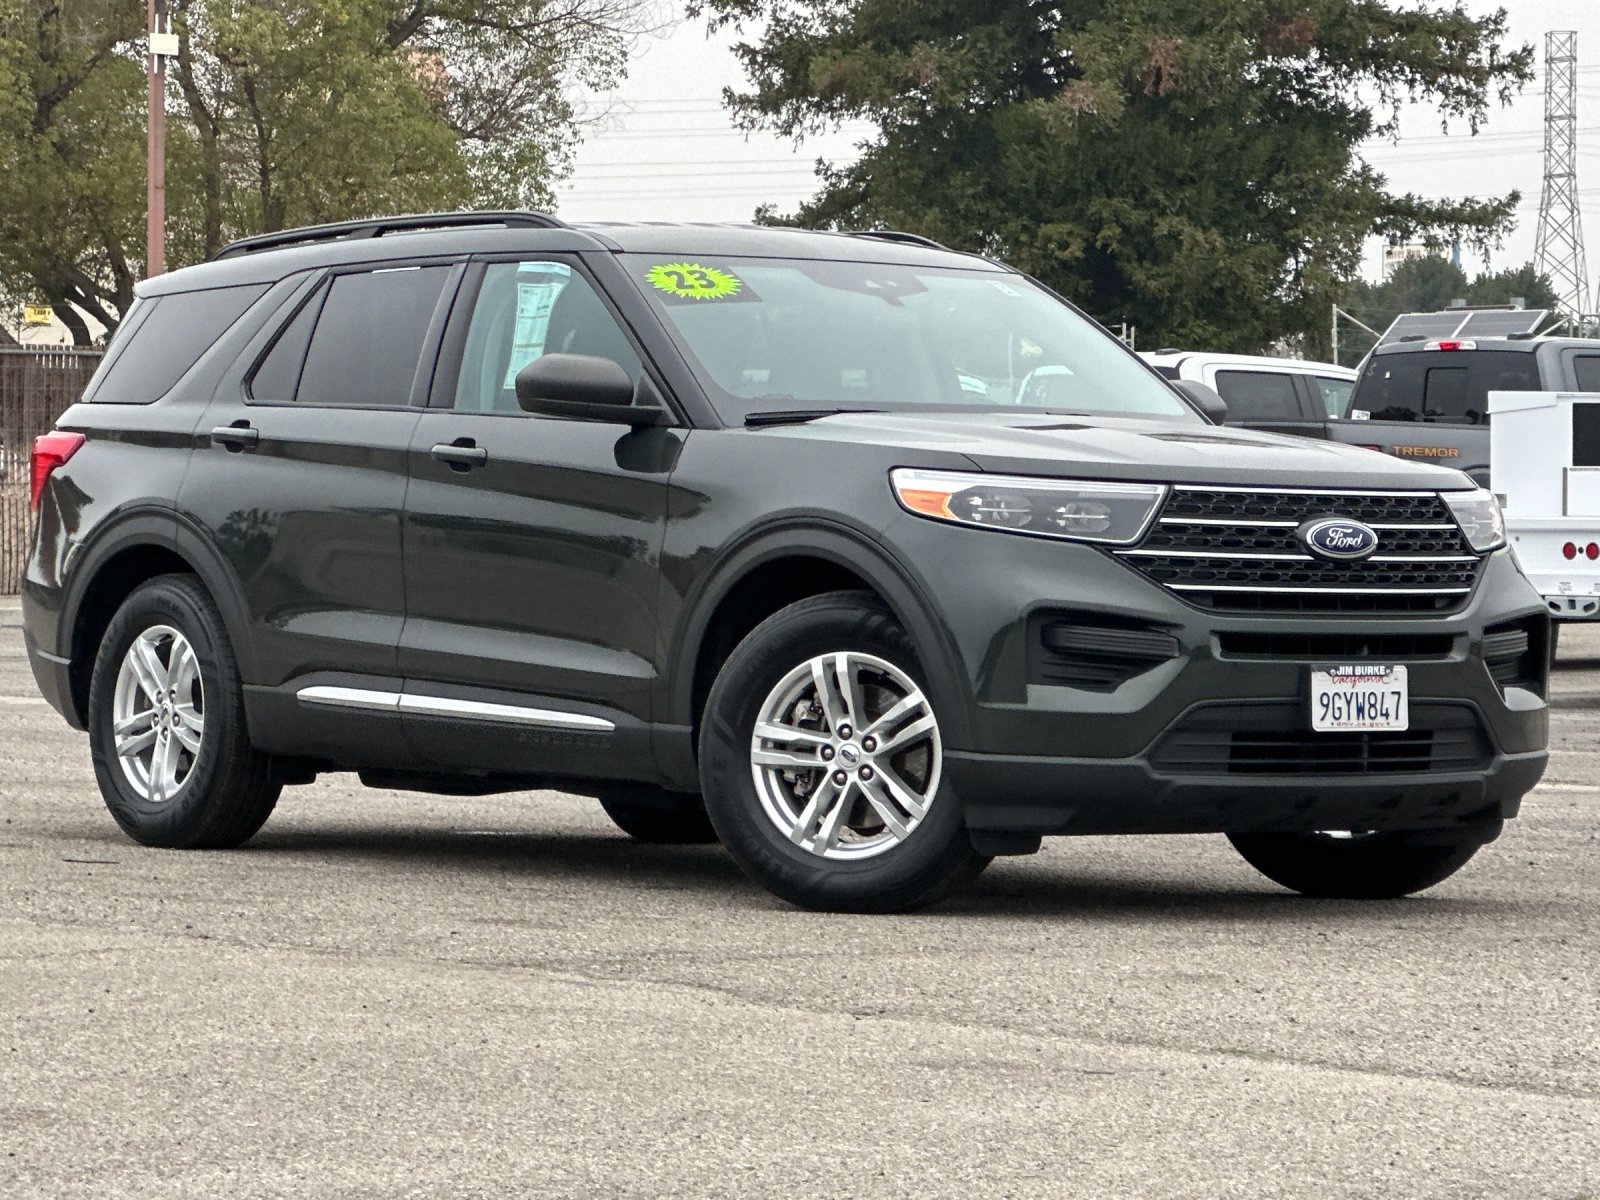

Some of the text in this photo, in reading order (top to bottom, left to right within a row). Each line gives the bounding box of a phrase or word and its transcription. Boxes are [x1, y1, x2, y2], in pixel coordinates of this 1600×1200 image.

[664, 270, 715, 289] 23
[1392, 445, 1459, 457] TREMOR
[1326, 527, 1363, 549] Ford
[1337, 666, 1386, 675] JIM BURKE
[1320, 691, 1402, 721] 9GYW847
